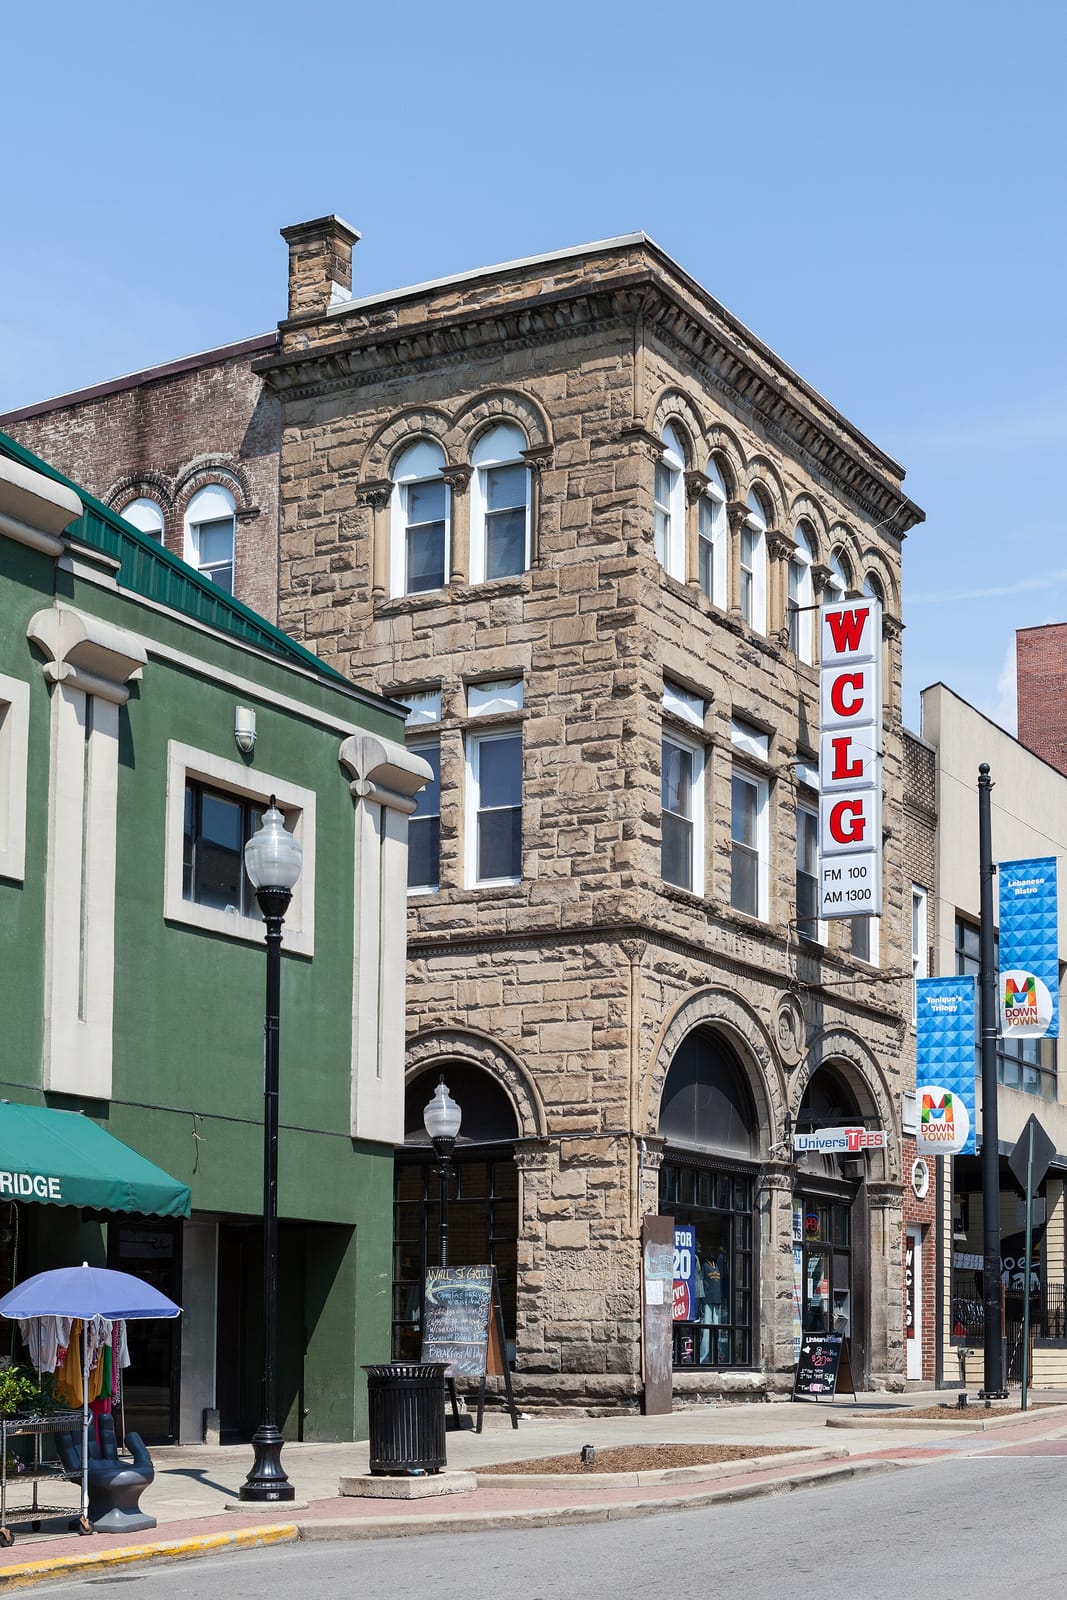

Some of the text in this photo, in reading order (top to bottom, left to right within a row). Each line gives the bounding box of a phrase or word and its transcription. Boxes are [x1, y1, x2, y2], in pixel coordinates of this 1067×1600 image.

[825, 608, 869, 843] WCLG
[824, 866, 867, 881] FM 100
[1007, 878, 1045, 887] Lebanese
[824, 889, 872, 903] AM 1300
[1014, 887, 1038, 895] Bistro
[926, 995, 963, 1004] Tonique's
[931, 1004, 958, 1012] Trilogy
[1005, 1007, 1038, 1018] DOWN
[1006, 1016, 1039, 1026] TOWN
[921, 1123, 955, 1133] DOWN
[921, 1132, 955, 1142] TOWN
[0, 1171, 62, 1199] RIDGE
[674, 1231, 693, 1247] FOR
[427, 1269, 453, 1281] WALL
[466, 1267, 493, 1280] GRILL
